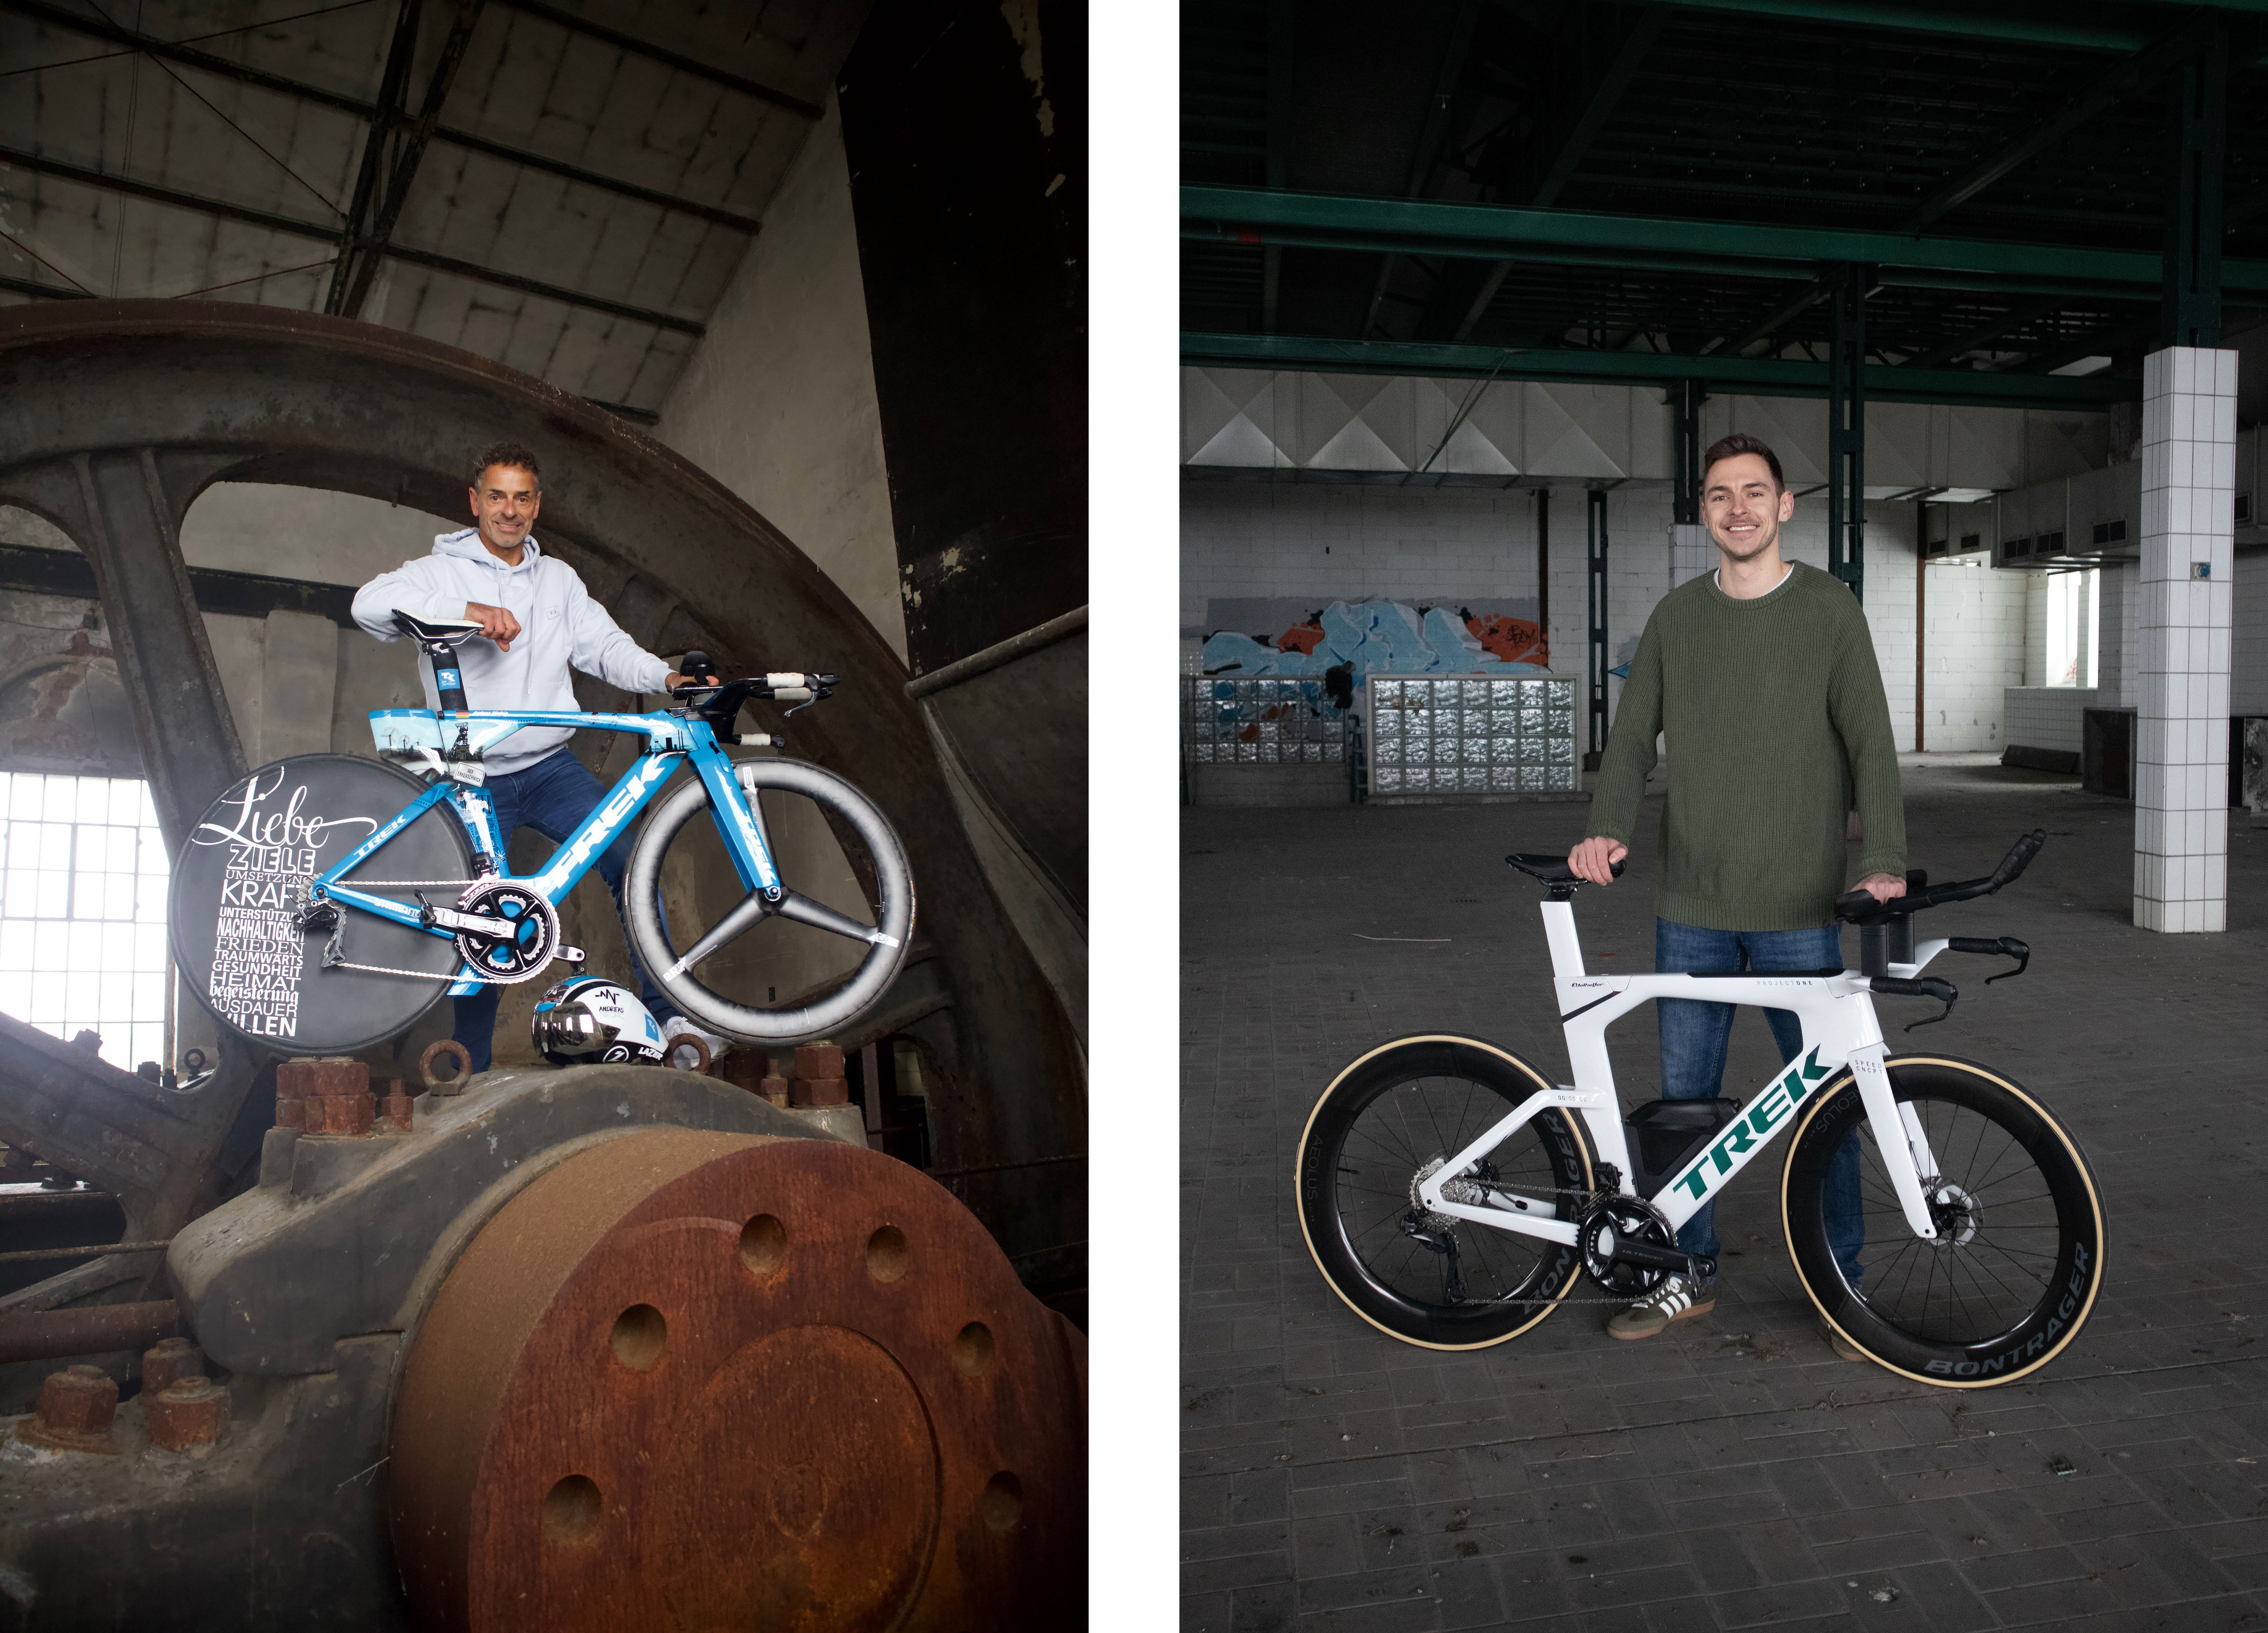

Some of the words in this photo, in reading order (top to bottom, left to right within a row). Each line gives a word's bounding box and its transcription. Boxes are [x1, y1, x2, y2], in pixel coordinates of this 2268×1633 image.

[457, 771, 481, 783] ERKENSCHWICK
[191, 766, 377, 849] Liebe
[543, 752, 665, 889] TREK
[353, 814, 407, 858] TREK
[740, 810, 777, 885] TREK
[227, 844, 316, 875] ZIELE
[226, 869, 306, 885] UMSETZUN
[221, 879, 301, 909] KRAF
[219, 906, 298, 922] UNTERSTÜTZU
[214, 949, 303, 967] TRAUMWÄRTS
[215, 936, 305, 956] FRIEDEN
[210, 971, 302, 991] HEIMAT
[212, 960, 303, 978] GESUNDHEIT
[209, 980, 300, 1006] begeisterung
[638, 1046, 664, 1061] LAZER
[1855, 1060, 1882, 1069] SPEED
[1856, 1066, 1882, 1075] CNCPT
[1672, 1043, 1833, 1201] TREK
[1816, 1090, 1859, 1133] EOLUS
[1307, 1135, 1323, 1200] AEOLUS
[1525, 1113, 1582, 1315] BONRAGER
[1924, 1242, 2088, 1375] BONTRAGER
